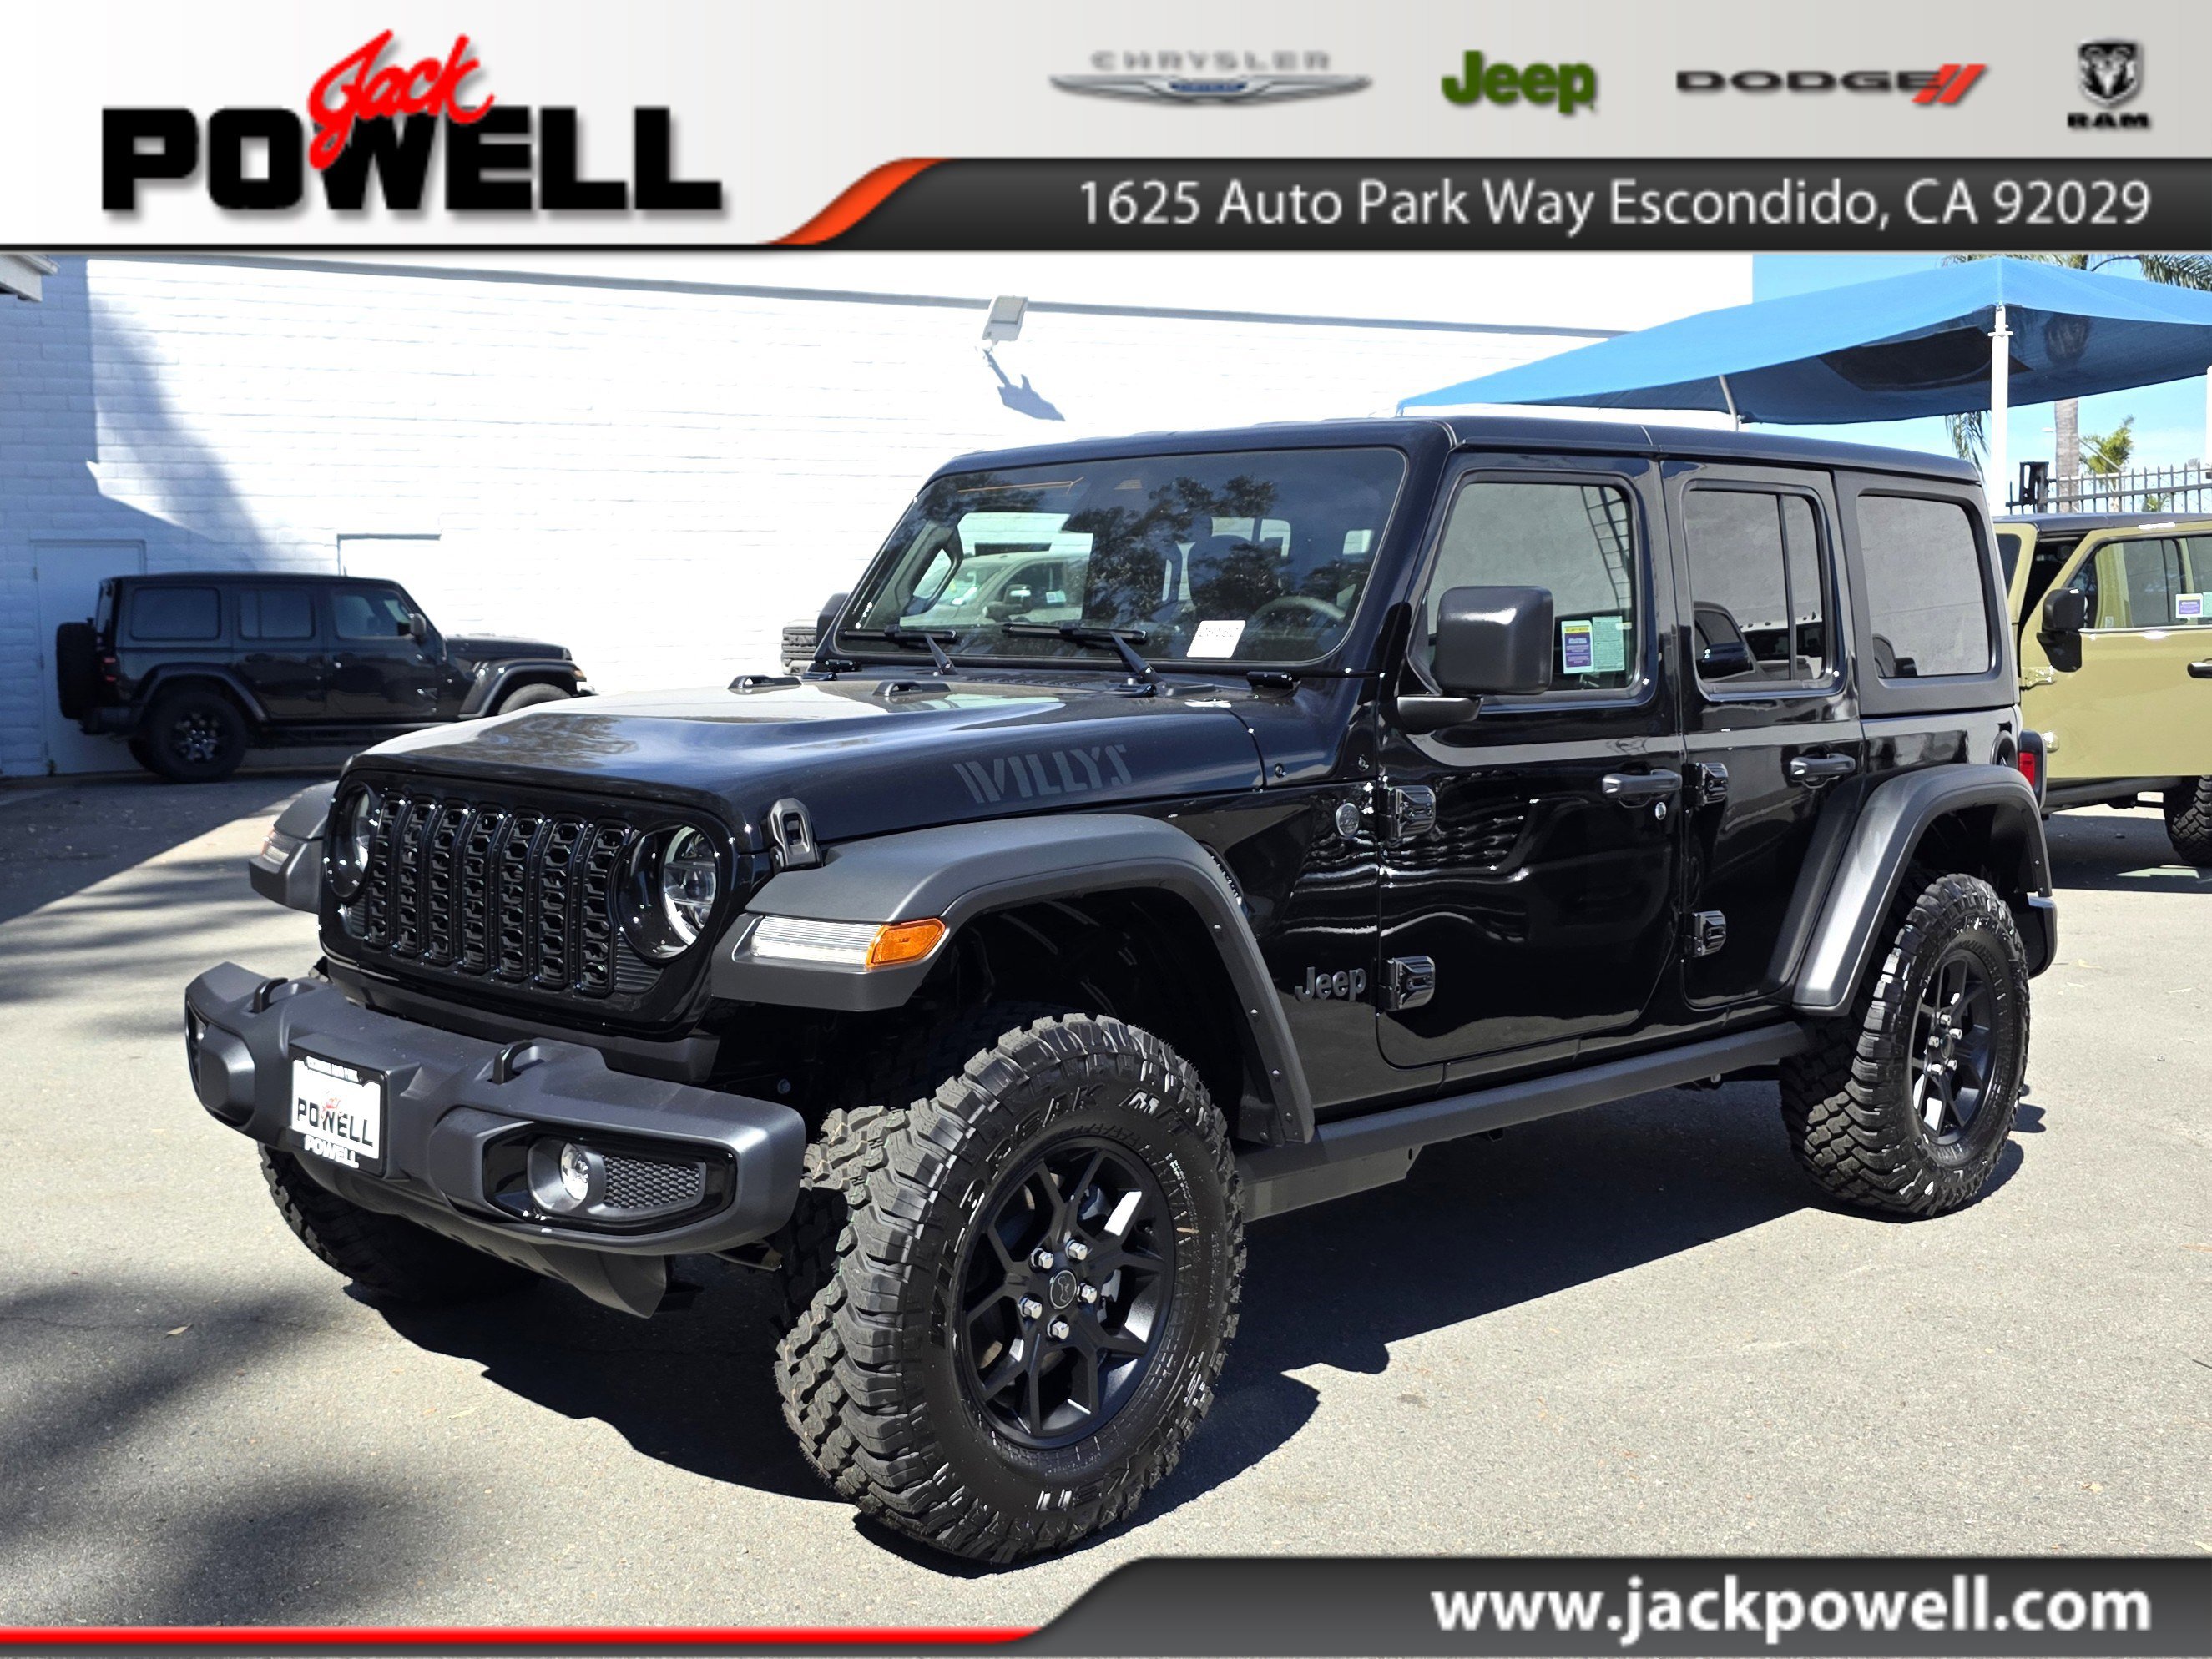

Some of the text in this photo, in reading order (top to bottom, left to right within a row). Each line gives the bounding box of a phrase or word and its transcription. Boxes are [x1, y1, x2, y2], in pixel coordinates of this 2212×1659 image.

[952, 744, 1133, 804] WILLYS
[1294, 966, 1367, 1003] Jeep
[297, 1097, 374, 1147] POWELL
[304, 1133, 360, 1169] POWELL
